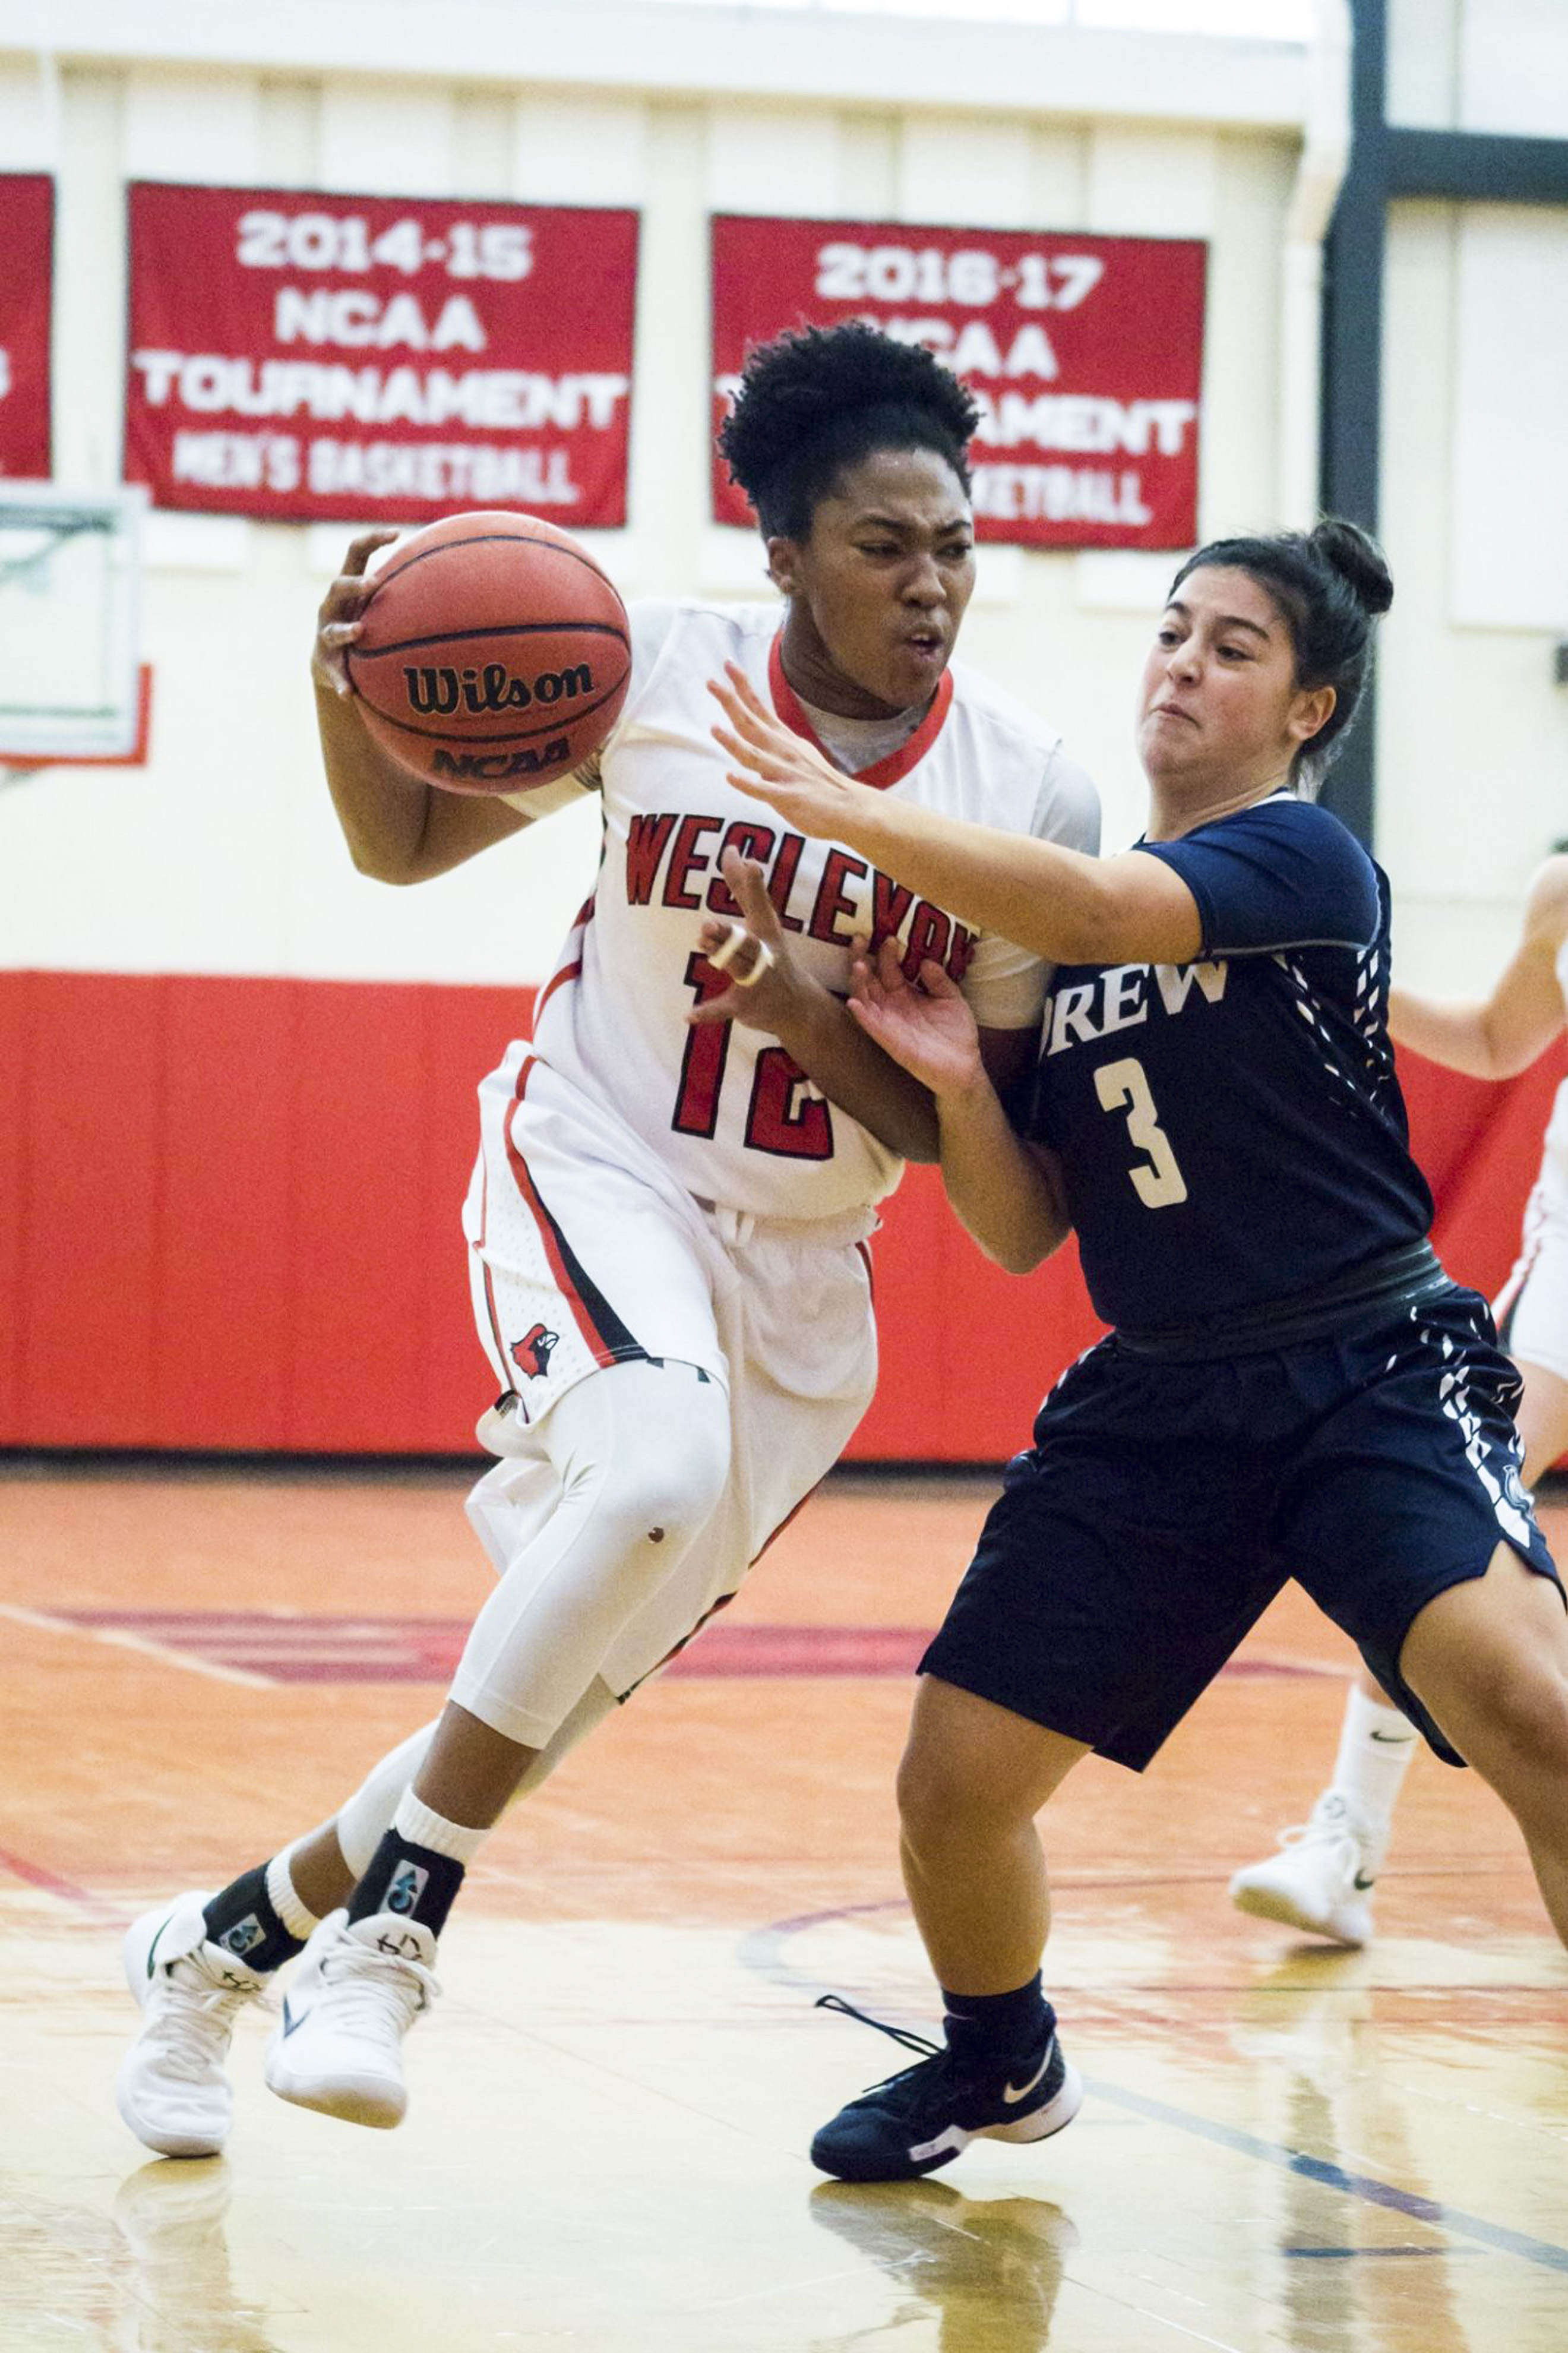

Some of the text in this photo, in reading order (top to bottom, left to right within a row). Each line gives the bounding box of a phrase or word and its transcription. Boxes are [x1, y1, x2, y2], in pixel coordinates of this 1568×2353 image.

[238, 210, 534, 282] 2014-15
[274, 288, 487, 352] NCAA
[851, 314, 1058, 381] CAA
[132, 349, 630, 429] TOURNAMENT
[173, 431, 580, 504] MEN'S BASKETBALL
[404, 662, 594, 715] Wilson
[432, 735, 571, 780] NCAA
[1039, 959, 1228, 1065] REW
[671, 950, 834, 1162] 12
[1093, 1057, 1188, 1209] 3
